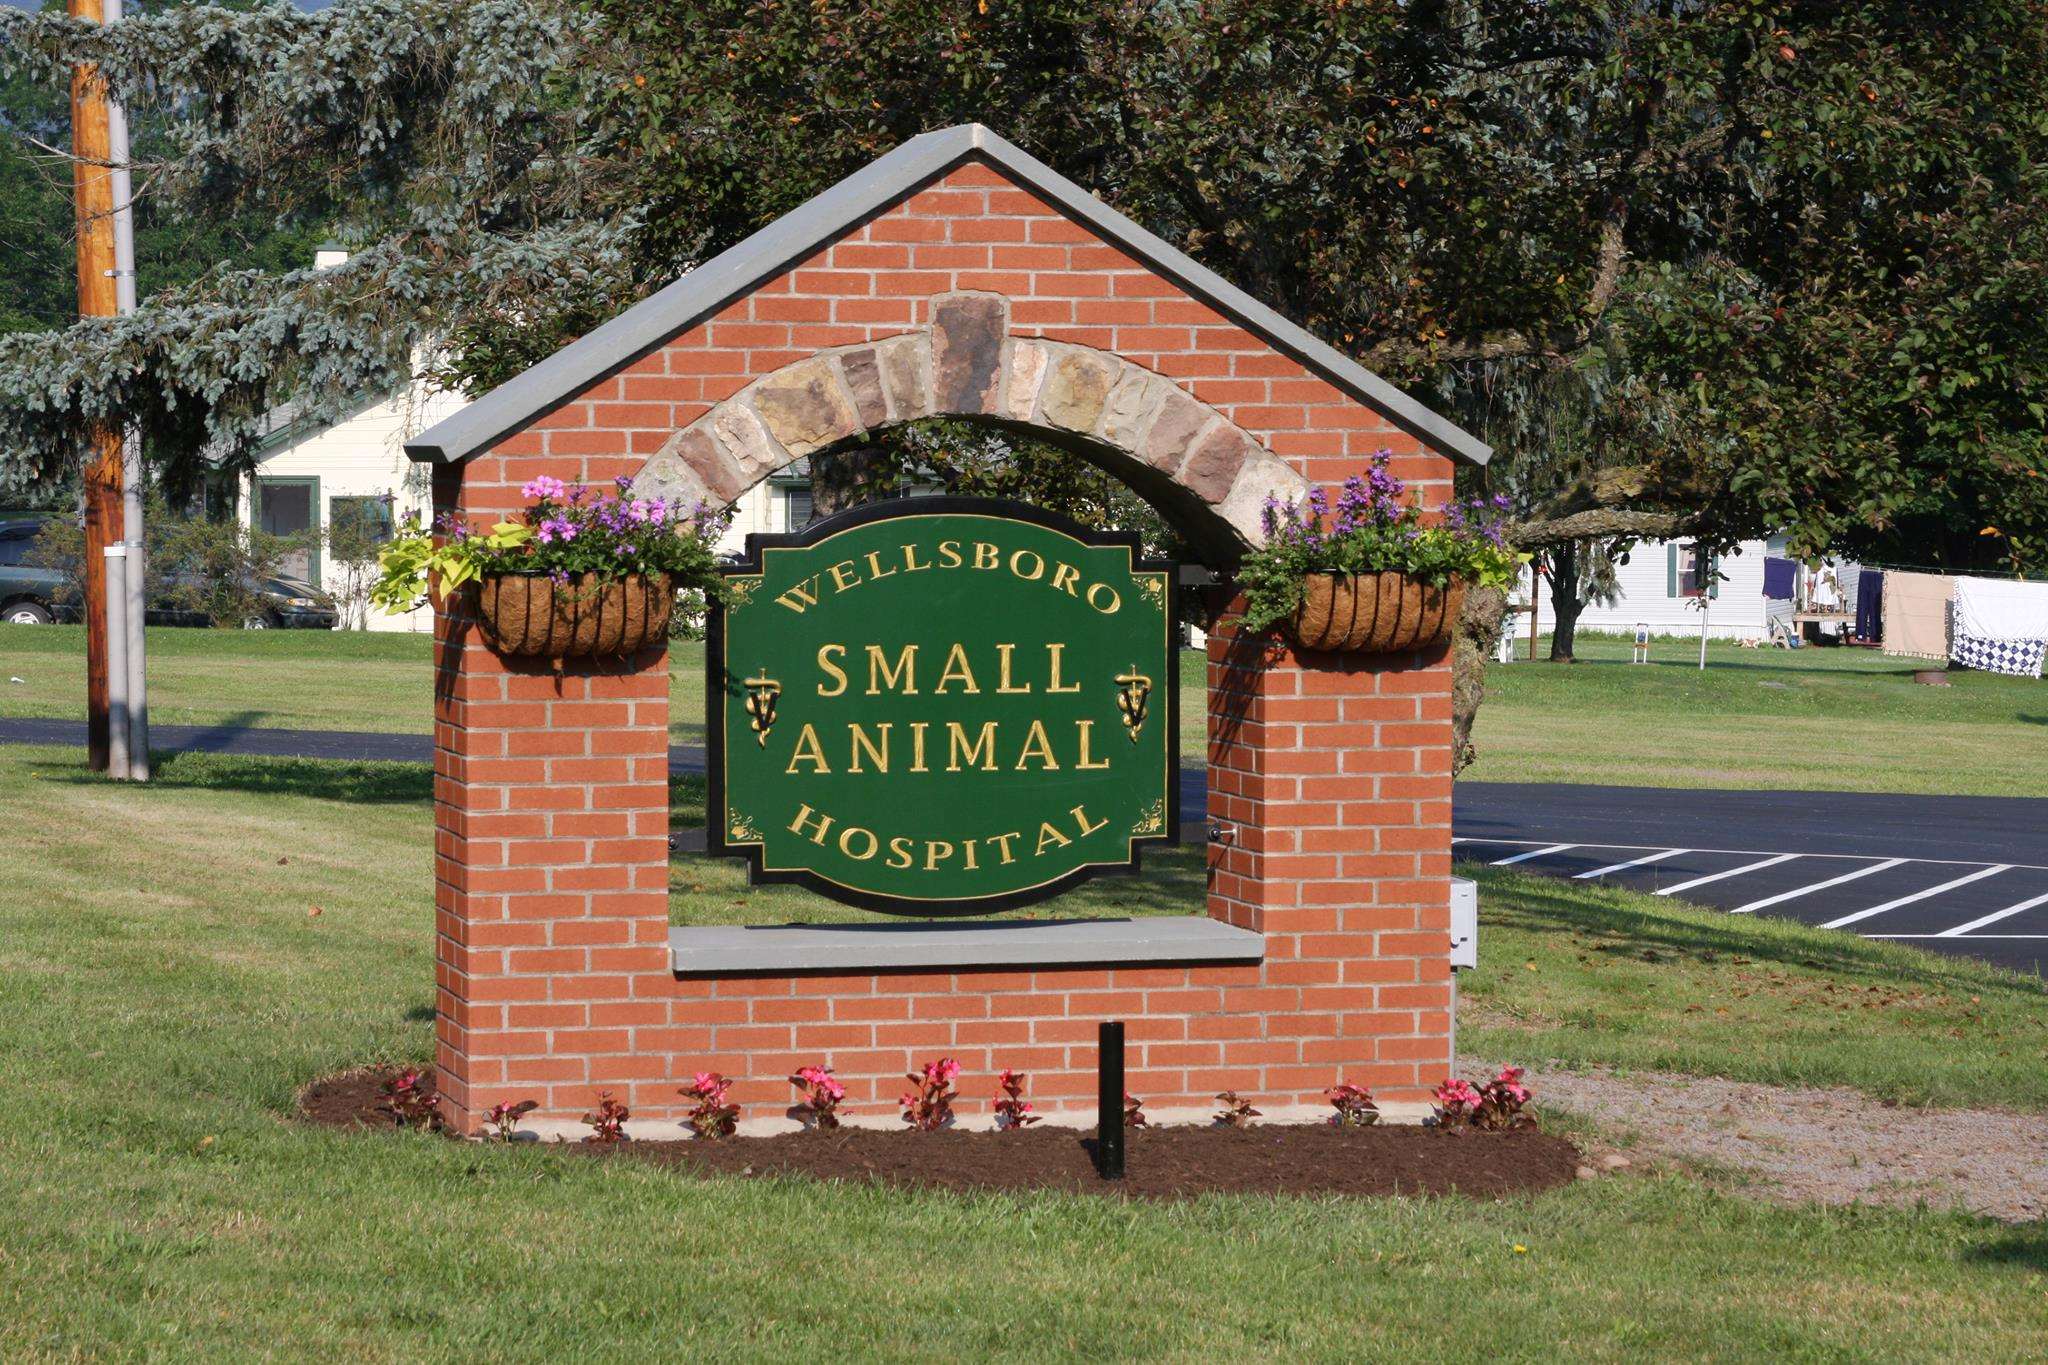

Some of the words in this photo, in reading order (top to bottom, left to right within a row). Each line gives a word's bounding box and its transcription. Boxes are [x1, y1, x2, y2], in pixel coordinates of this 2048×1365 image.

[775, 541, 1121, 614] WELLSBORO
[817, 643, 1081, 696] SMALL
[785, 720, 1110, 774] ANIMAL
[786, 803, 1109, 871] HOSPITAL
